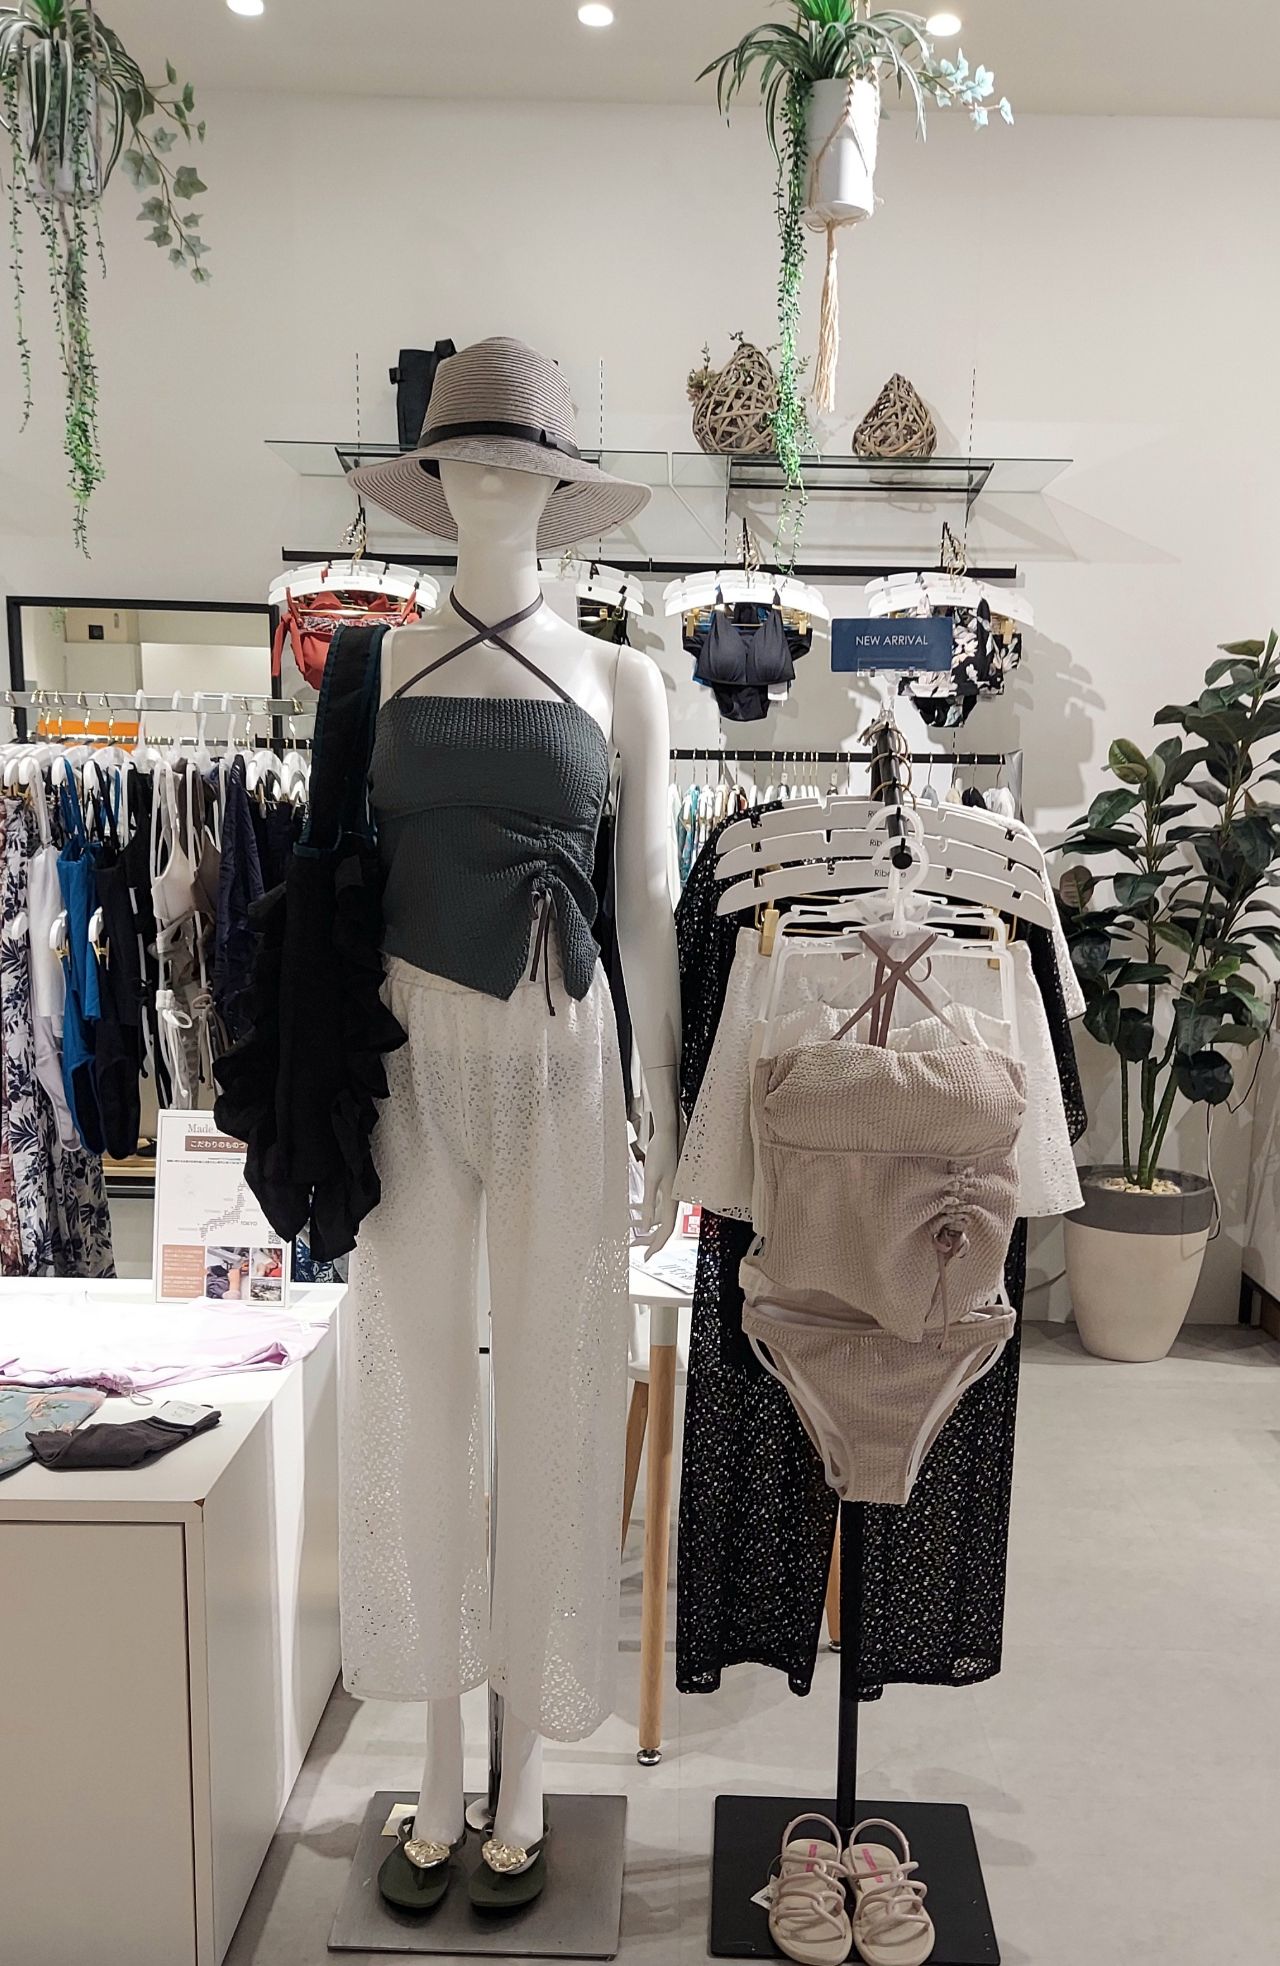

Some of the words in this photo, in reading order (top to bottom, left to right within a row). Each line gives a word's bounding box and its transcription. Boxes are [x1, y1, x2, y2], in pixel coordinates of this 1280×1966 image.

[855, 635, 880, 646] NEW
[883, 635, 928, 646] ARRIVAL
[187, 1123, 214, 1134] Made
